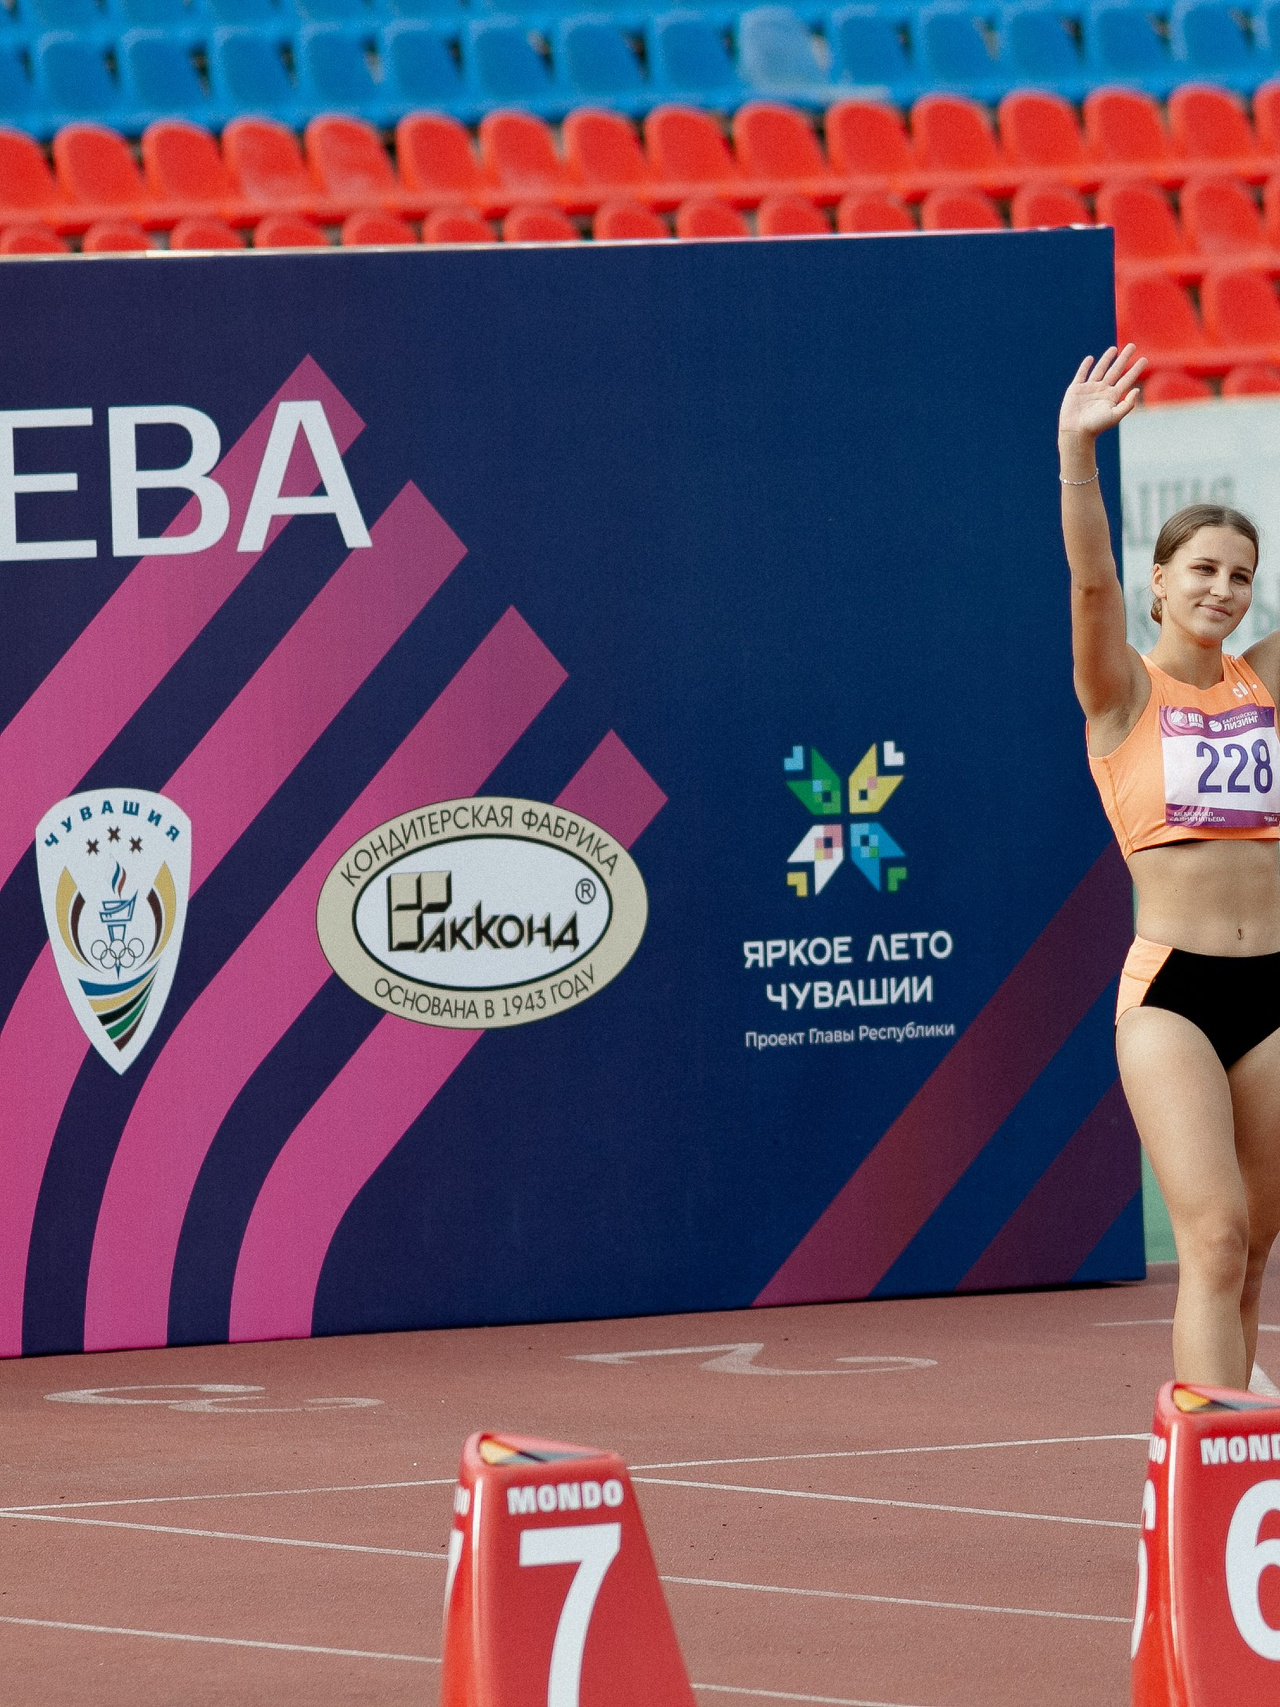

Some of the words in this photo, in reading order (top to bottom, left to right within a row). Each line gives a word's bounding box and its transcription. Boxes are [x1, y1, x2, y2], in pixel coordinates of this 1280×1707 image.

[0, 400, 373, 561] ЕВА
[1196, 739, 1273, 794] 228
[44, 800, 180, 847] ЧУВАШИЯ
[340, 804, 514, 887] КОНДИТЕРСКАЯ
[521, 808, 620, 877] ФАБРИКА
[743, 936, 853, 969] ЯРКОЕ
[866, 930, 954, 962] ЛЕТО
[374, 977, 479, 1020] ОСНОВАНА
[485, 999, 495, 1019] В
[502, 989, 548, 1018] 1943
[550, 963, 595, 1005] ГОДУ
[766, 975, 934, 1011] ЧУВАШИИ
[745, 1031, 805, 1051] Проект
[809, 1027, 855, 1044] Главы
[859, 1021, 956, 1043] Республики
[506, 1479, 625, 1516] MONDO
[518, 1522, 622, 1707] 7
